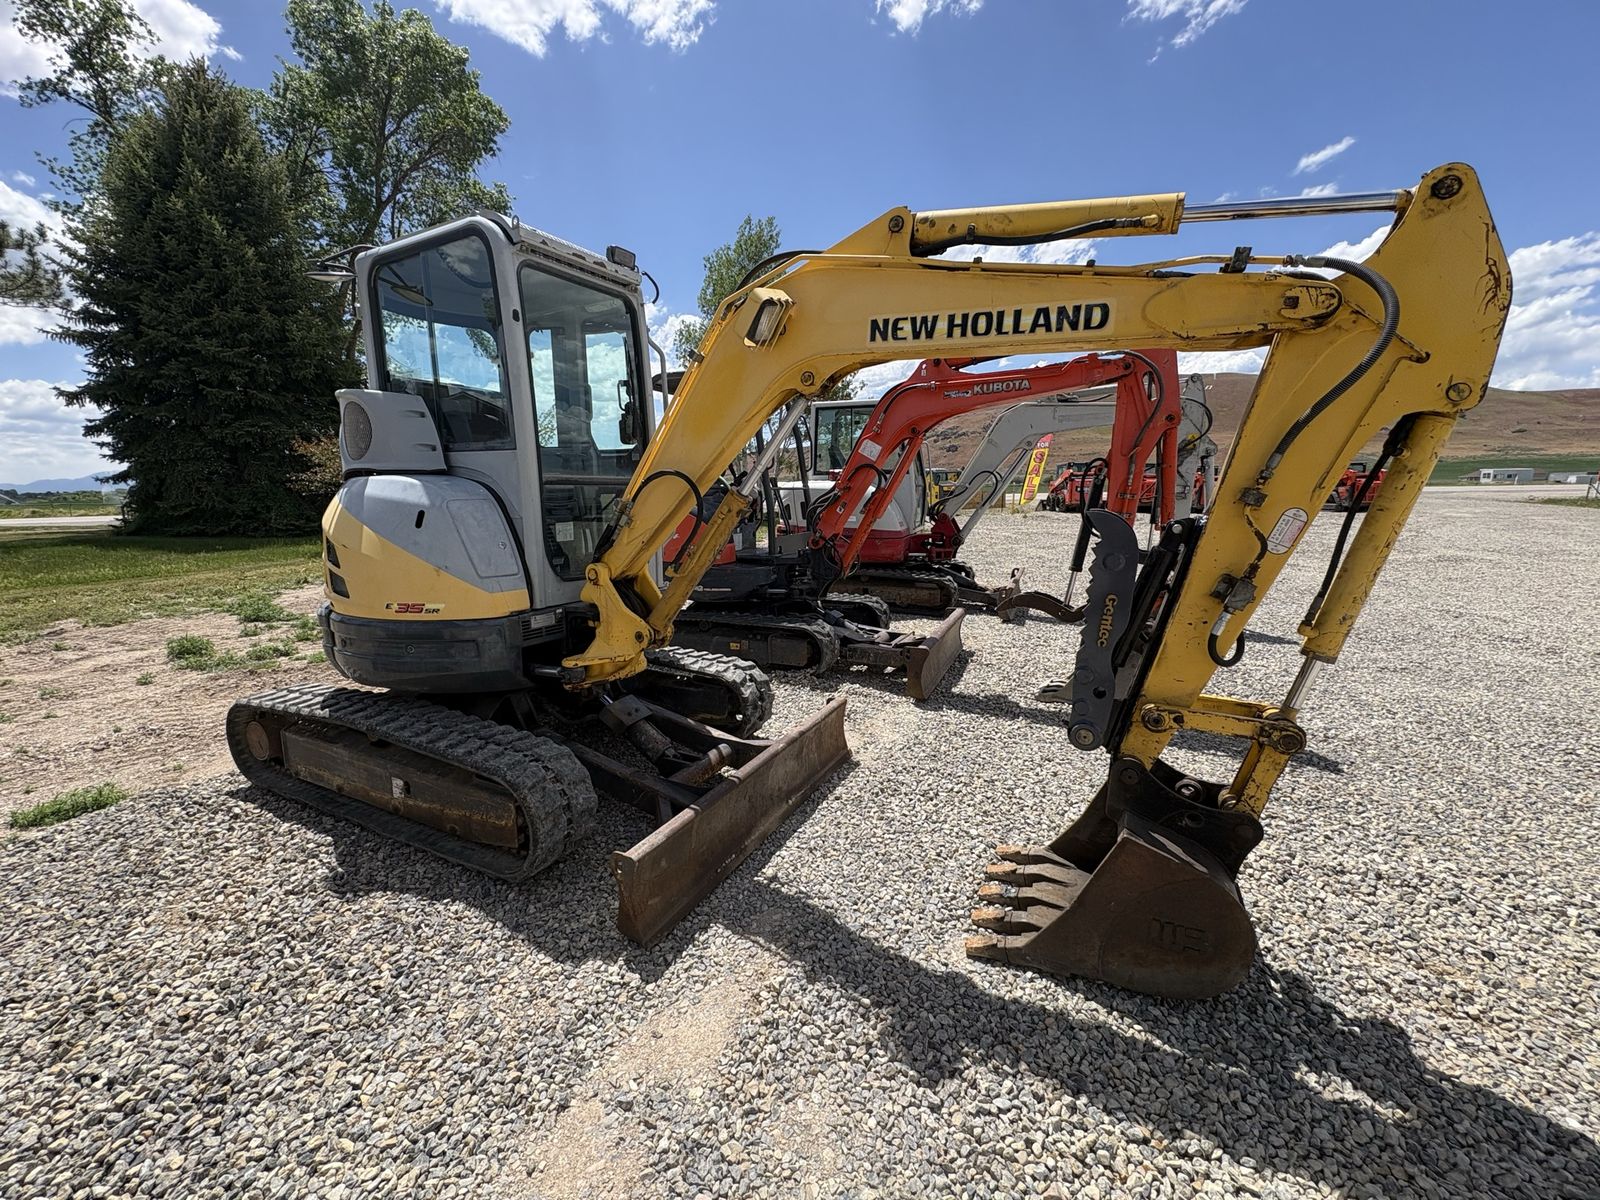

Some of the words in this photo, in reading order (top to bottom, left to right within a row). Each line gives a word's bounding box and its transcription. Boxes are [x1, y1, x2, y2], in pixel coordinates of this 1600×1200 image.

[869, 314, 939, 343] NEW
[946, 302, 1110, 339] HOLLAND
[973, 379, 1031, 395] KUBOTA
[1024, 450, 1045, 500] SALE
[1097, 594, 1118, 648] Gentec
